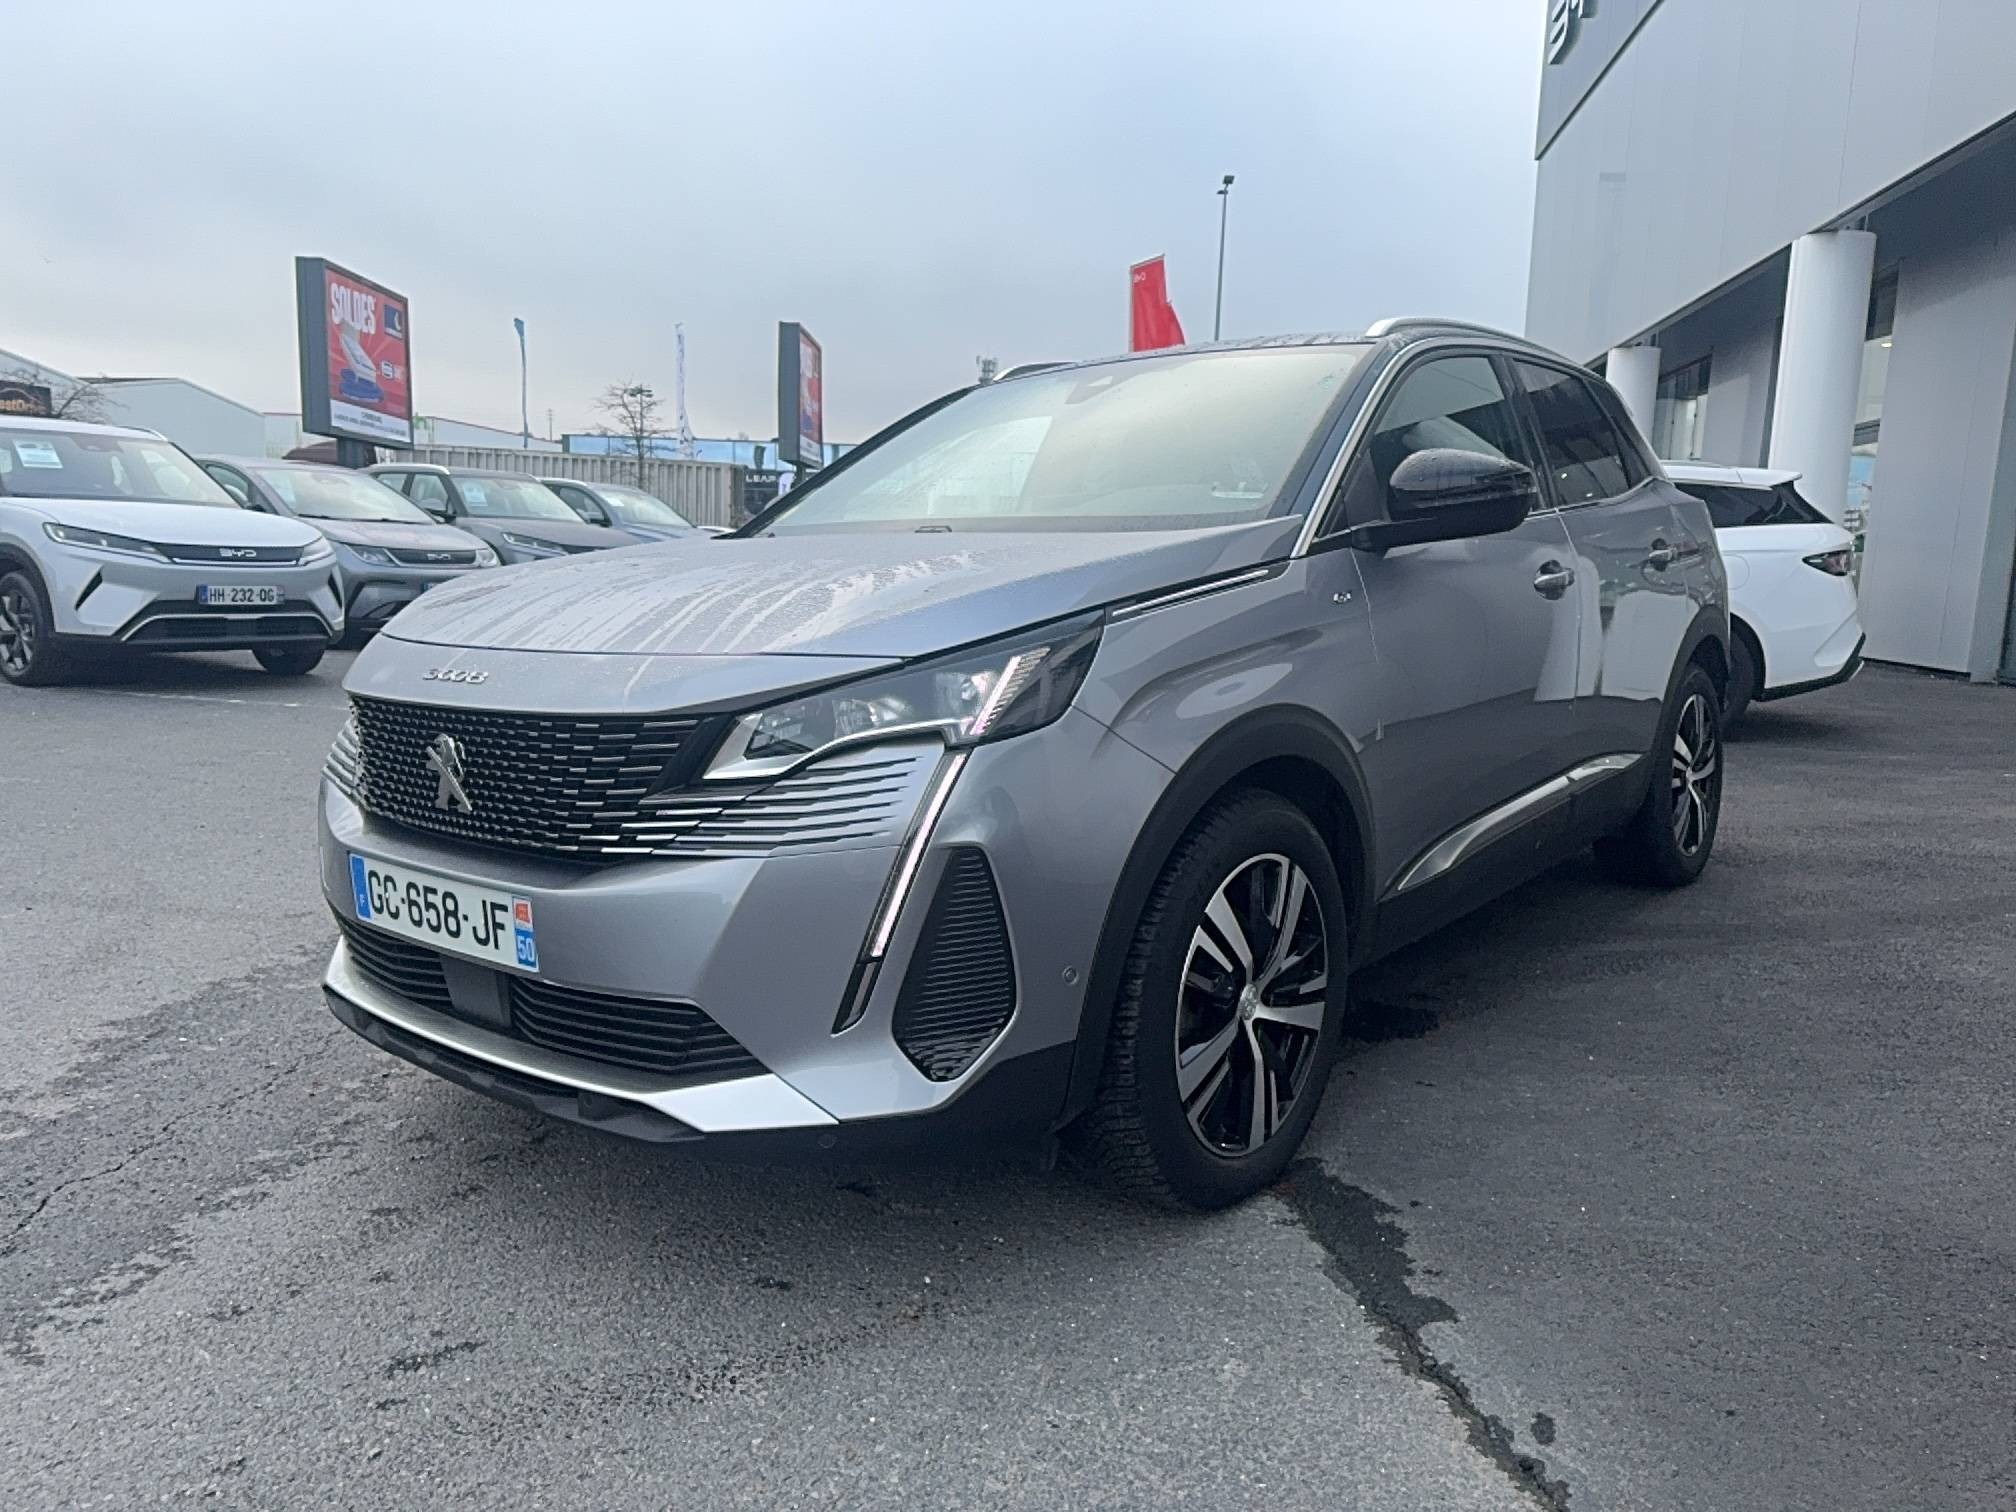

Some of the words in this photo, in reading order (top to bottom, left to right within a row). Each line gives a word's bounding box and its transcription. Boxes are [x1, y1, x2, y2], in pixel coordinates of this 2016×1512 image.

[331, 283, 376, 335] SOLDES
[367, 869, 509, 950] GC-658-JF
[518, 935, 536, 962] 50
